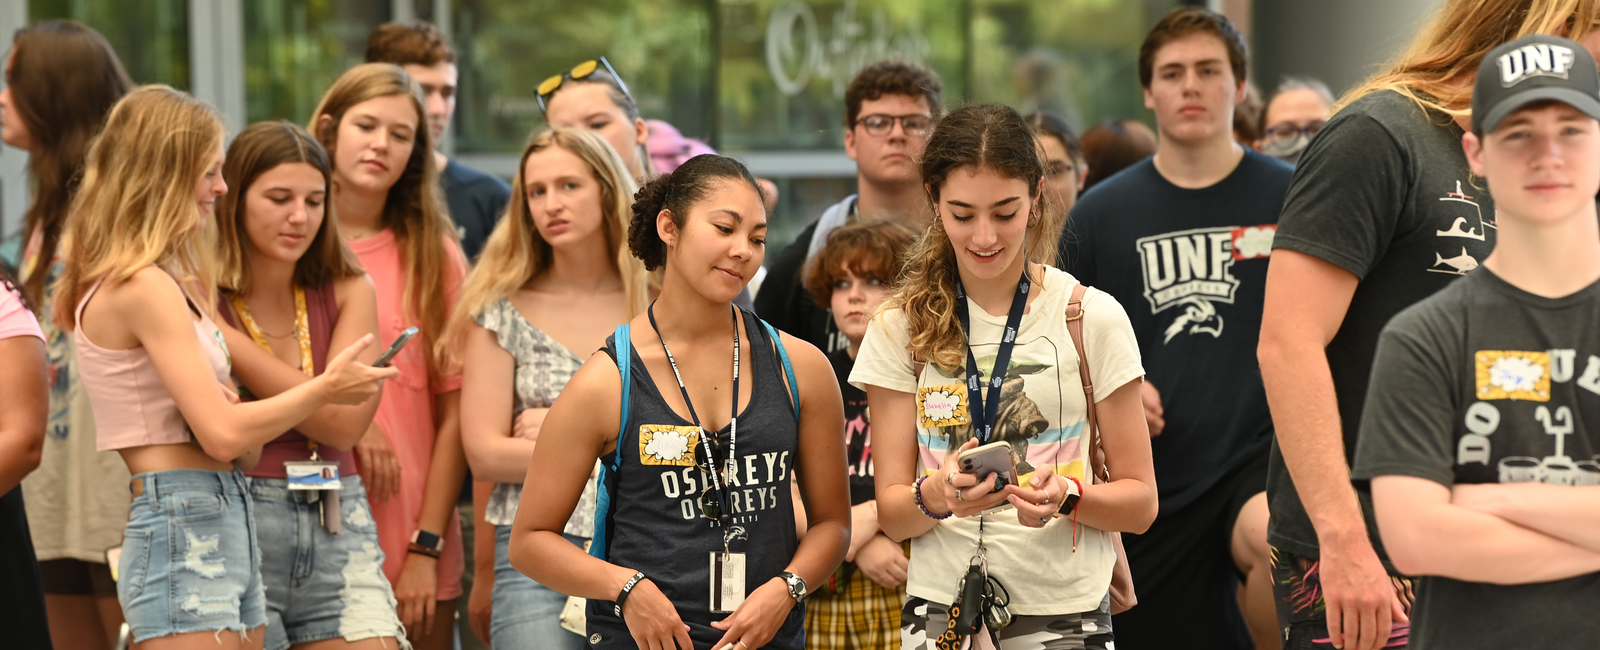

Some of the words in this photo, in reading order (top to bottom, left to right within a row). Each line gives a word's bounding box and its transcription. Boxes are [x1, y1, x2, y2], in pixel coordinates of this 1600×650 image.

[1498, 44, 1573, 83] UNF
[1142, 232, 1232, 291] UNF
[657, 441, 678, 450] Lidia
[680, 486, 777, 520] OREYS
[710, 514, 758, 528] OSREYS
